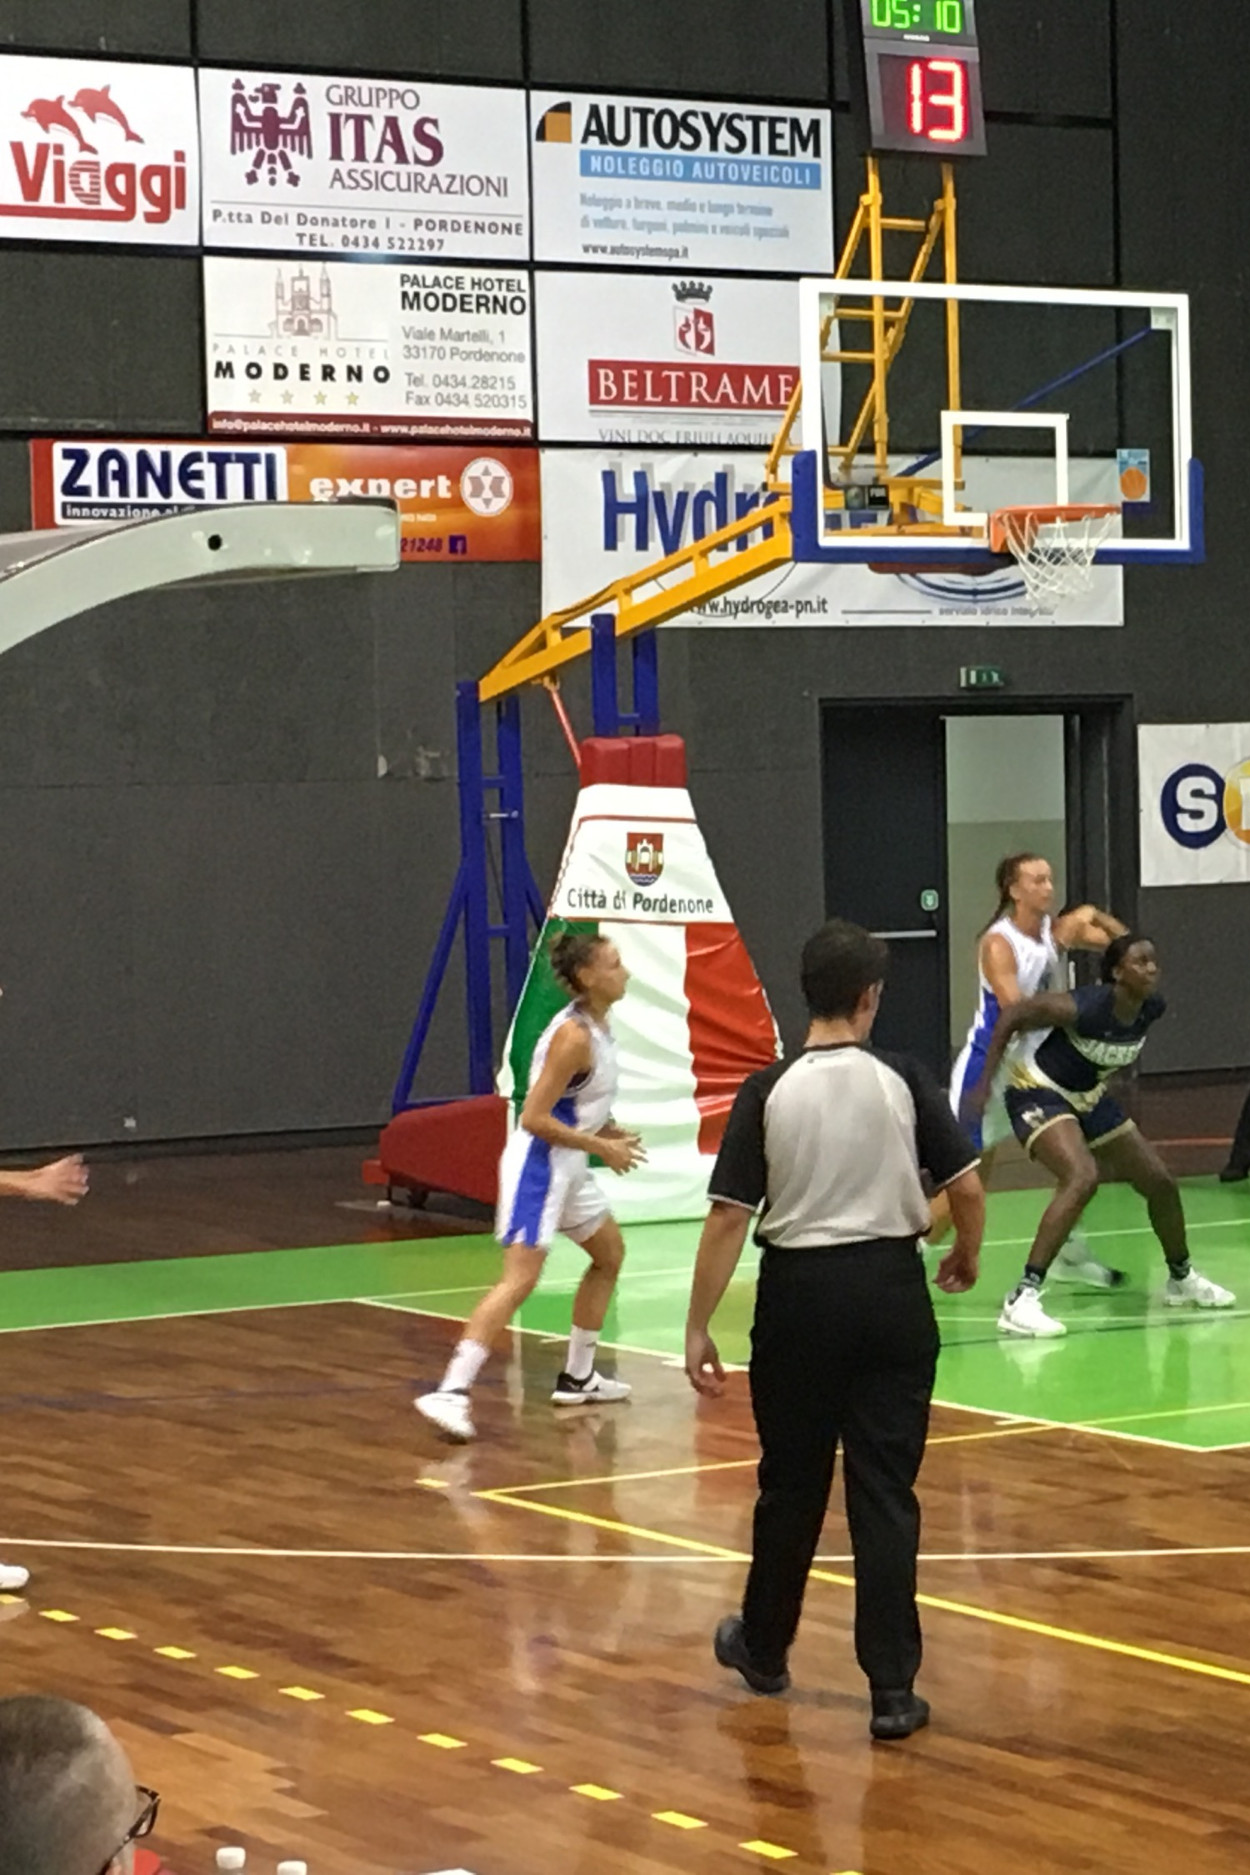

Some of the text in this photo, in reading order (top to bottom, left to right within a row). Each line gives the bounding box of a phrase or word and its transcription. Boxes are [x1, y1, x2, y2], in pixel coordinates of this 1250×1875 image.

[326, 84, 420, 110] GRUPPO
[910, 60, 964, 142] 13
[328, 112, 444, 167] ITAS
[581, 104, 821, 158] AUTOSYSTEM
[9, 141, 186, 224] Viaggi
[590, 156, 811, 185] NOLEGGIO AUTOVEICOLI
[330, 169, 508, 198] ASSICURAZIONI
[213, 209, 253, 224] P.tta
[261, 211, 289, 226] Del
[297, 213, 376, 229] Donatore
[414, 219, 523, 236] PORDENONE
[296, 233, 444, 252] TEL. 0434 522297
[400, 273, 526, 293] PALACE HOTEL
[401, 291, 526, 316] MODERNO
[402, 326, 437, 341] Viale
[440, 327, 494, 345] Martelli,
[212, 343, 390, 360] PALACE HOTEL
[403, 345, 525, 364] 33170 Pordenone
[214, 360, 391, 384] MODERNO
[406, 373, 428, 388] Tel.
[597, 367, 794, 405] BELTRAME
[406, 392, 431, 407] Fax
[212, 418, 370, 434] info@palacehotelmoderno.it
[381, 424, 532, 437] www.palacehotelmoderno.it
[60, 448, 277, 501] ZANETTI
[690, 596, 828, 620] w.hydrogea-pn.it
[567, 887, 714, 914] Città di Pordenone
